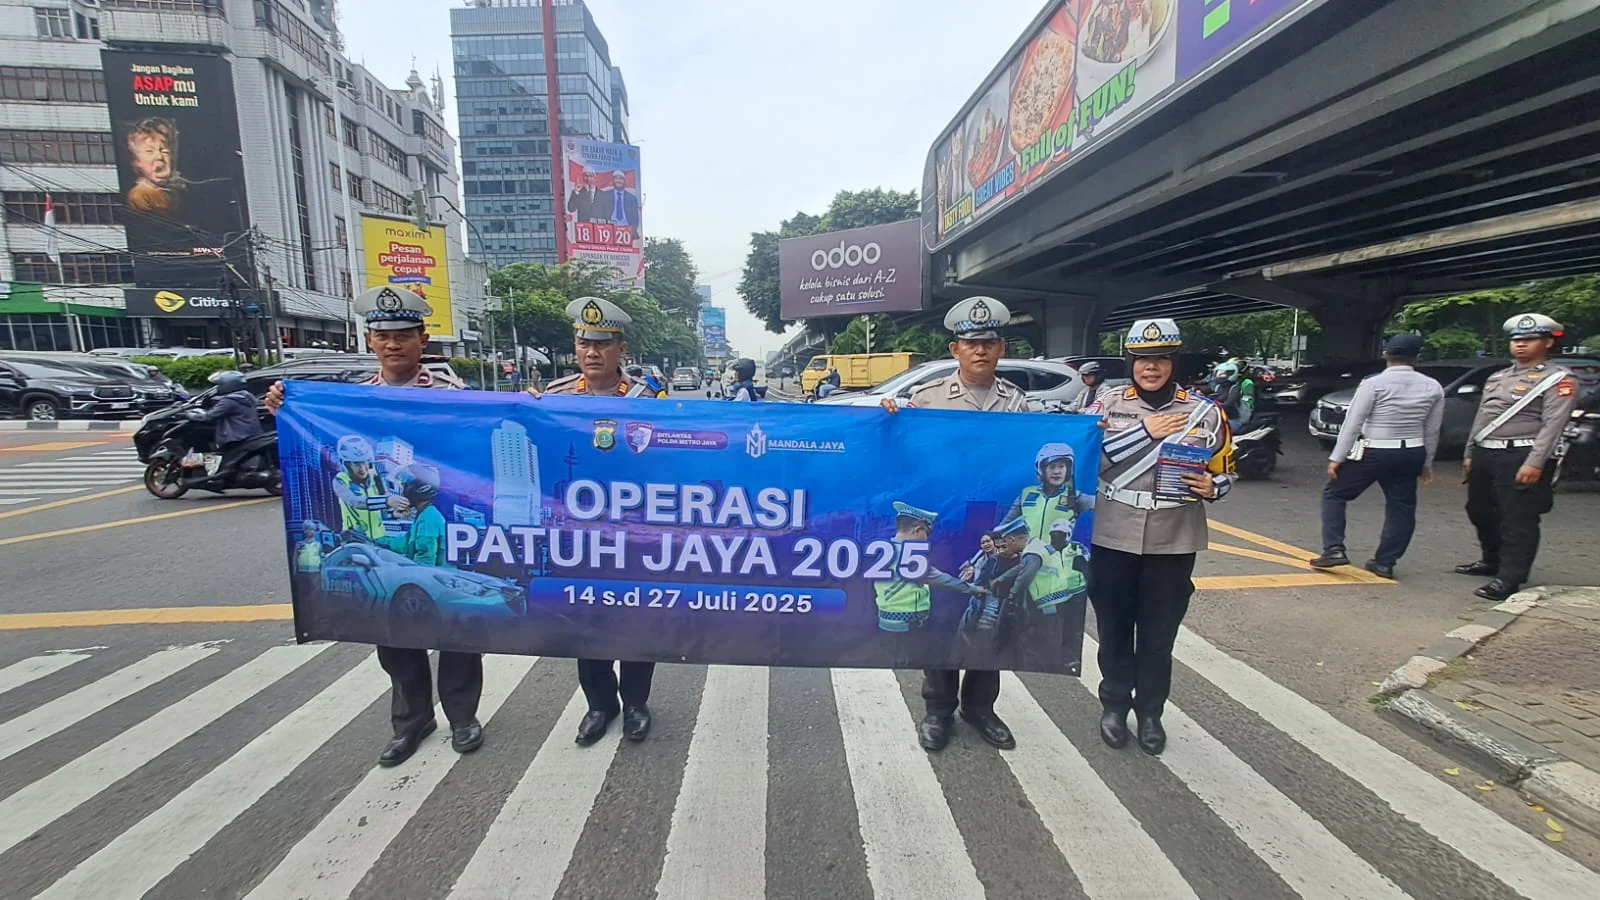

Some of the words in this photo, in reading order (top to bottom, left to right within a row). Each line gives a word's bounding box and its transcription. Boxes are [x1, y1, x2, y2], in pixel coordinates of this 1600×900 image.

[131, 64, 160, 75] Jangan
[161, 65, 194, 76] Bagikan
[135, 93, 170, 106] Untuk
[171, 95, 199, 107] kami
[1020, 128, 1052, 174] Full
[1054, 108, 1076, 151] of
[1079, 58, 1137, 132] FUN!
[385, 228, 425, 239] maxim
[577, 227, 590, 242] 18
[598, 229, 611, 243] 19
[615, 230, 631, 245] 20
[391, 243, 421, 253] Pesan
[811, 240, 881, 270] odoo
[380, 254, 433, 265] perjalanan
[394, 265, 422, 274] cepat
[799, 277, 822, 291] kelola
[825, 275, 850, 288] bisnis
[852, 273, 873, 285] dari
[189, 296, 244, 308] Cititra
[810, 292, 834, 307] cukup
[836, 291, 856, 302] satu
[768, 439, 817, 449] MANDALA
[818, 441, 845, 450] JAYA
[565, 478, 805, 528] OPERASI
[446, 522, 626, 569] PATUH
[641, 531, 778, 576] JAYA
[791, 537, 930, 579] 2025
[563, 585, 596, 605] 14
[602, 586, 640, 608] s.d
[648, 589, 681, 608] 27
[688, 590, 737, 611] Juli
[743, 592, 813, 614] 2025
